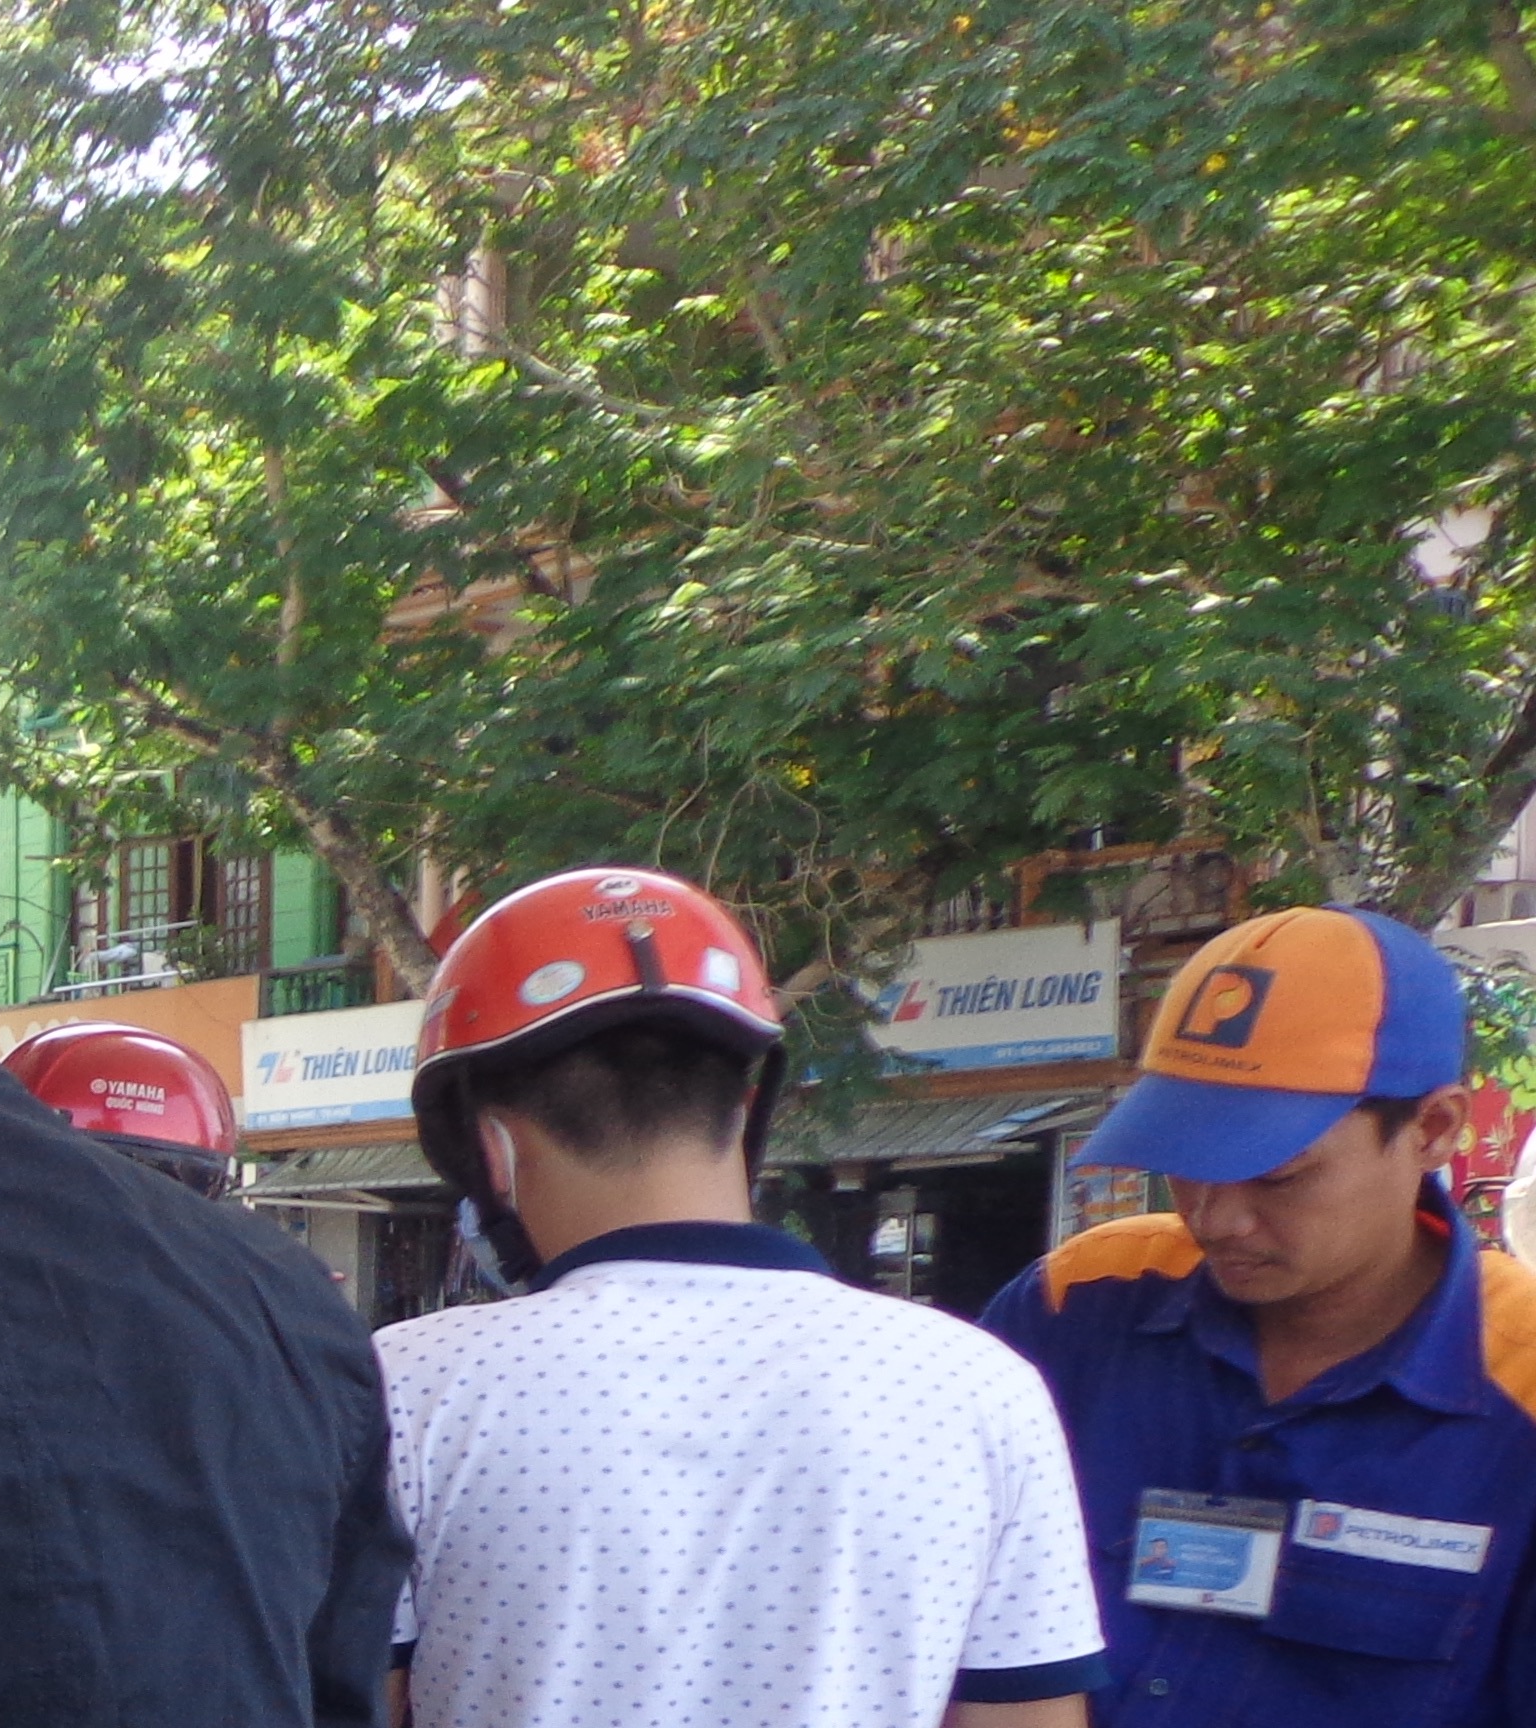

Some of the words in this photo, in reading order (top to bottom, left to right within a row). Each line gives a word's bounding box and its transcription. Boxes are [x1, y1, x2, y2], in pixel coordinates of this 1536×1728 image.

[582, 899, 675, 921] YAMAHA
[937, 974, 1017, 1018] THIÊN
[1021, 969, 1104, 1010] LONG
[302, 1046, 359, 1081] THIÊN
[362, 1043, 418, 1076] LONG
[108, 1080, 165, 1102] YAMAHA
[1345, 1524, 1480, 1555] PETROLIMEX
